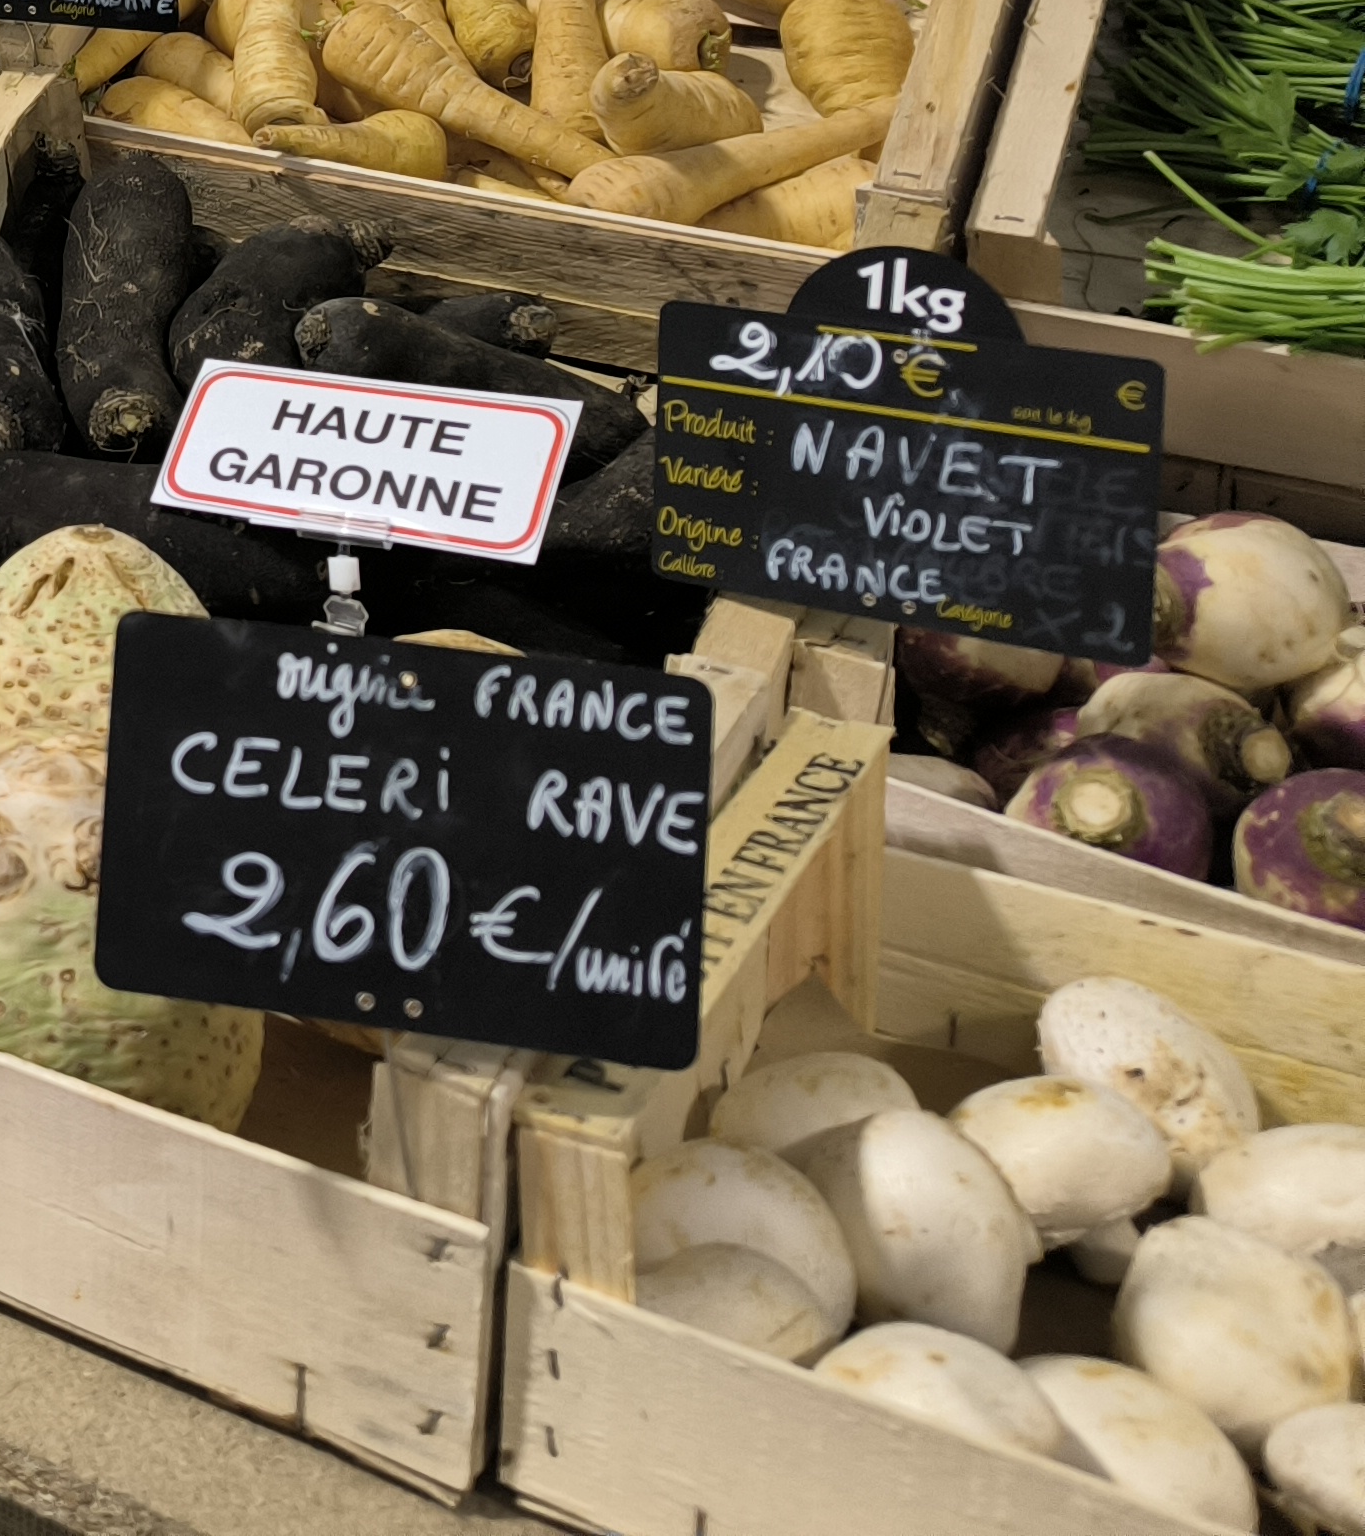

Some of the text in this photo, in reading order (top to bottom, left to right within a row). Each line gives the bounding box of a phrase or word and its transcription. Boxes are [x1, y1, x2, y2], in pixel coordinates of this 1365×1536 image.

[856, 257, 966, 334] 1kg
[271, 399, 471, 456] HAUTE
[663, 399, 1062, 505] Produit NAVET
[208, 447, 504, 523] GARONNE
[657, 504, 948, 605] Origine FRANCE
[474, 665, 694, 745] FRANCE
[526, 769, 705, 855] RAVE
[733, 751, 866, 875] FRANCE
[182, 840, 451, 982] 2,60
